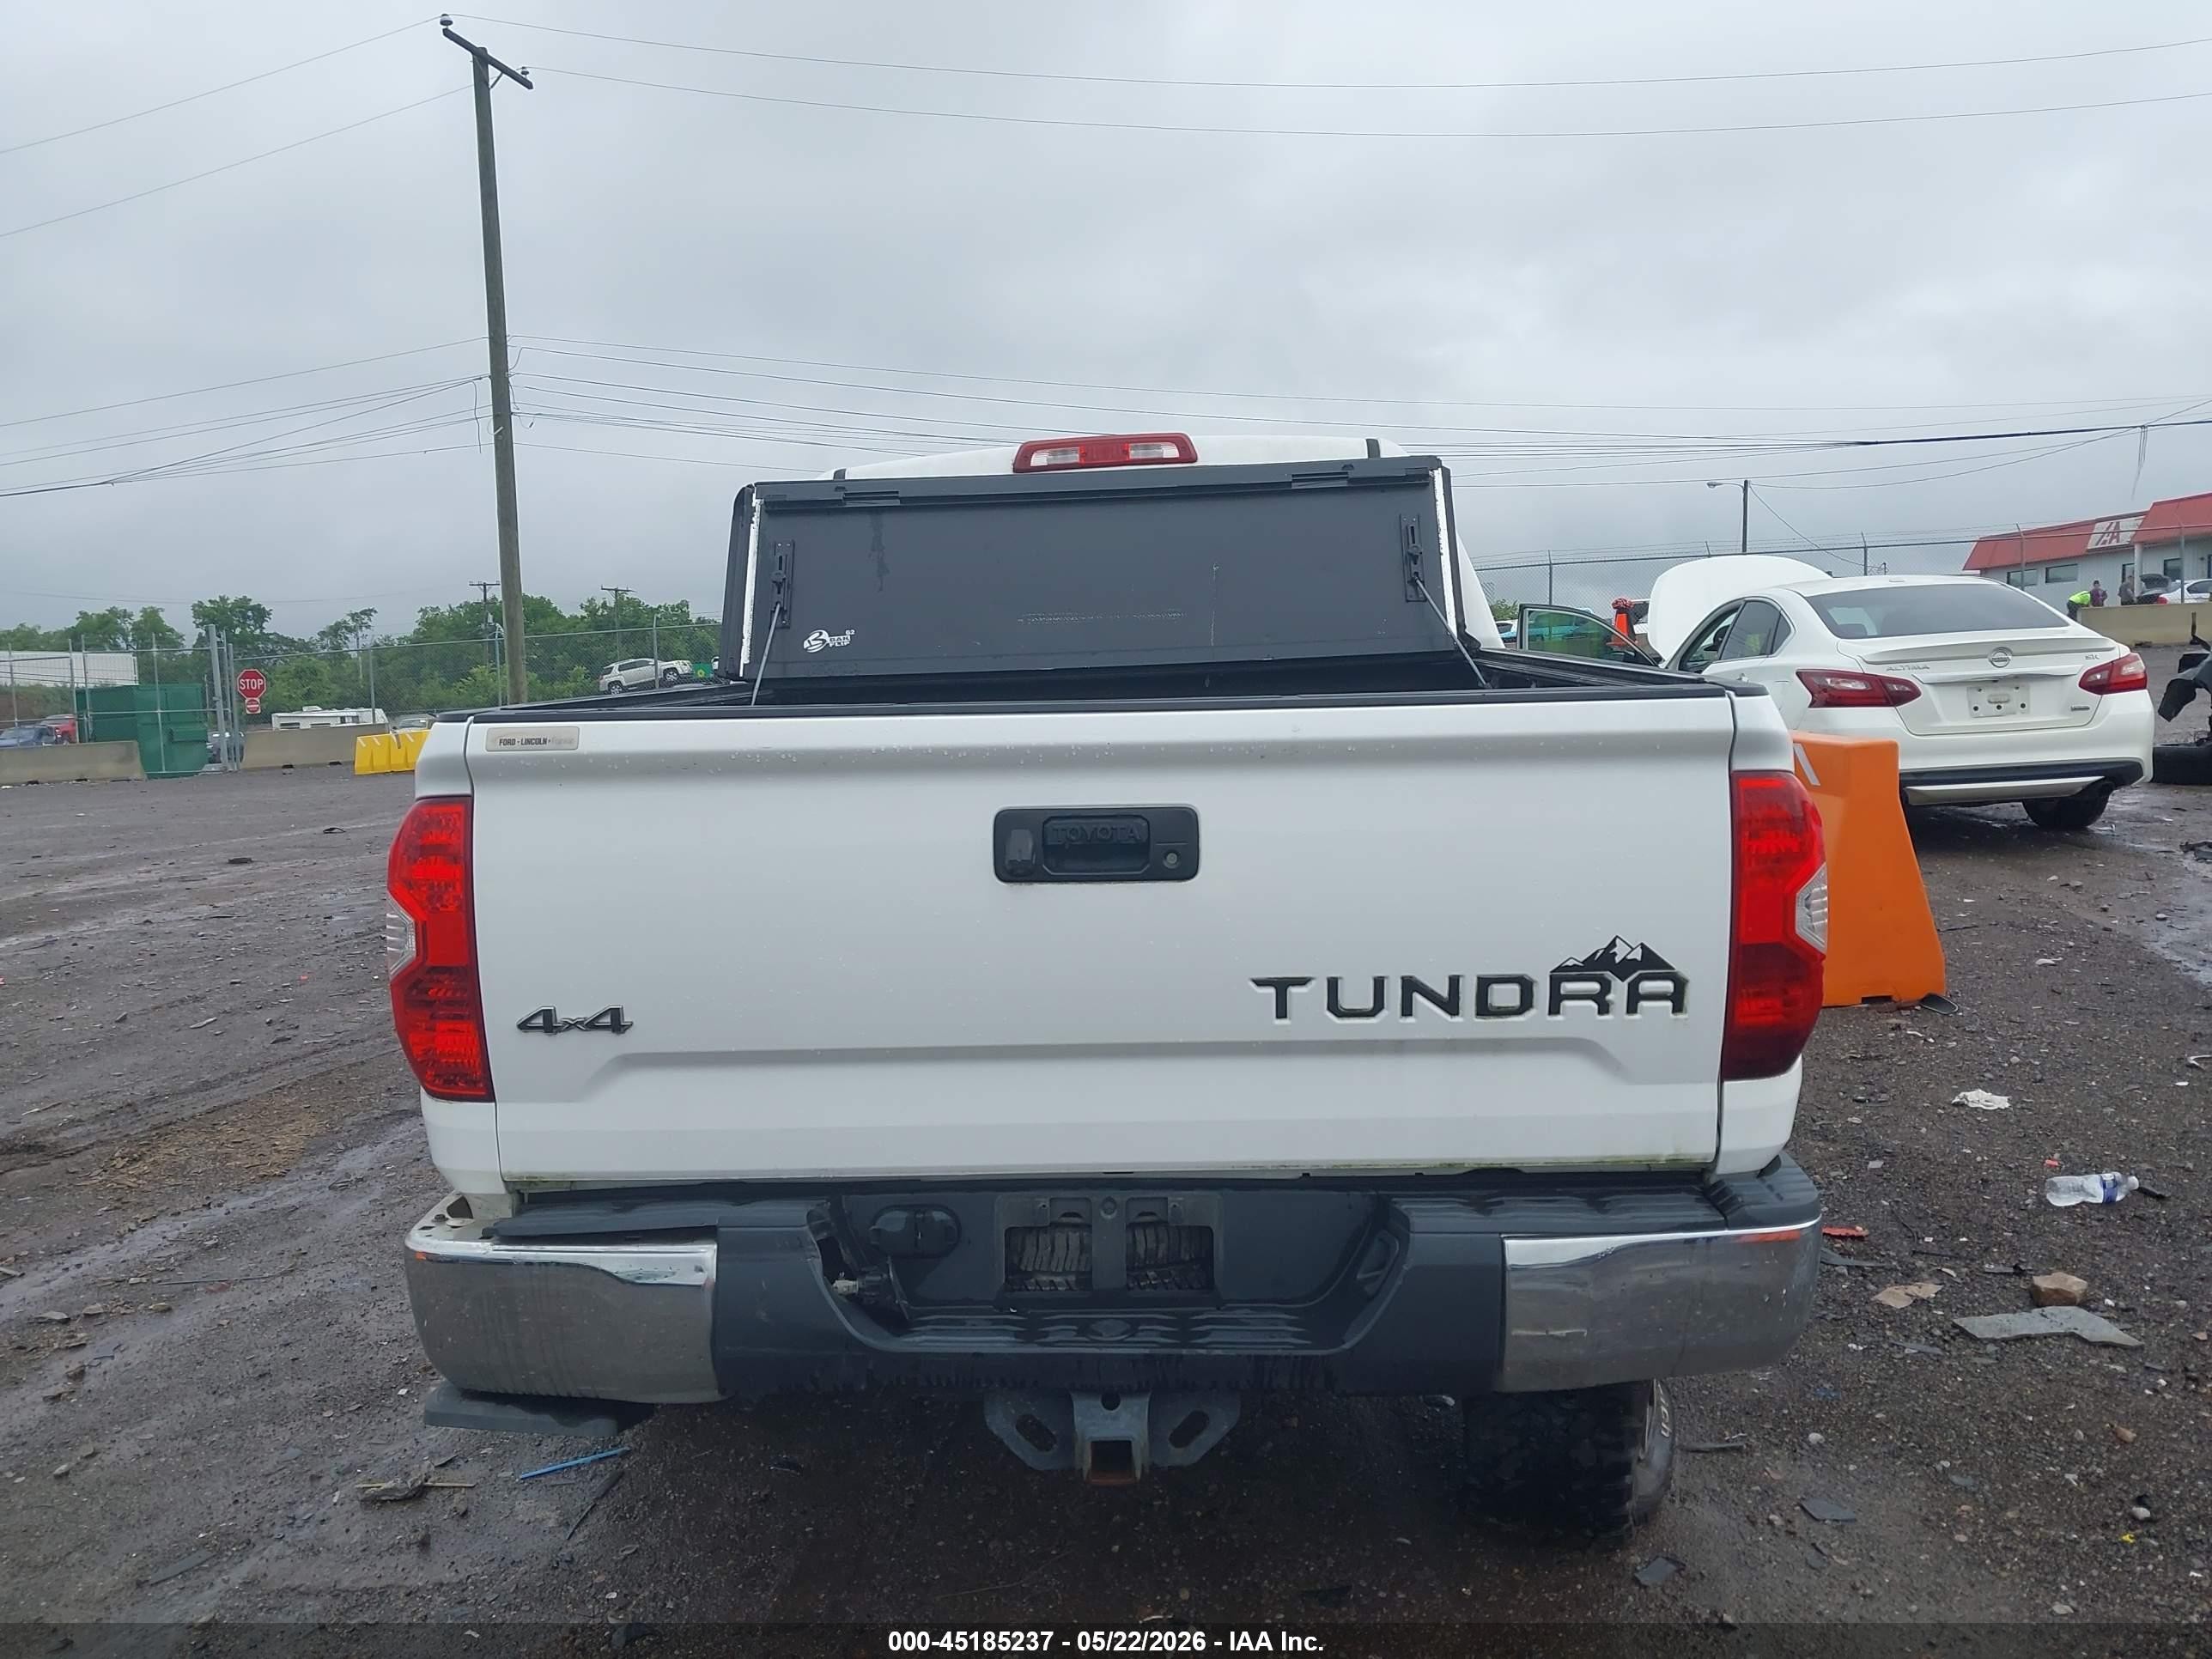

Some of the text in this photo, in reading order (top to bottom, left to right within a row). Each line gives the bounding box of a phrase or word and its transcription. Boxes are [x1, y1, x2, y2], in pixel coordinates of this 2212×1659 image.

[240, 678, 264, 690] STOP
[499, 738, 516, 746] FORD
[520, 737, 548, 746] LINCOLN
[1051, 823, 1142, 843] TOYOTA
[1250, 973, 1690, 1022] TUNDRA
[516, 1006, 634, 1035] 4x4
